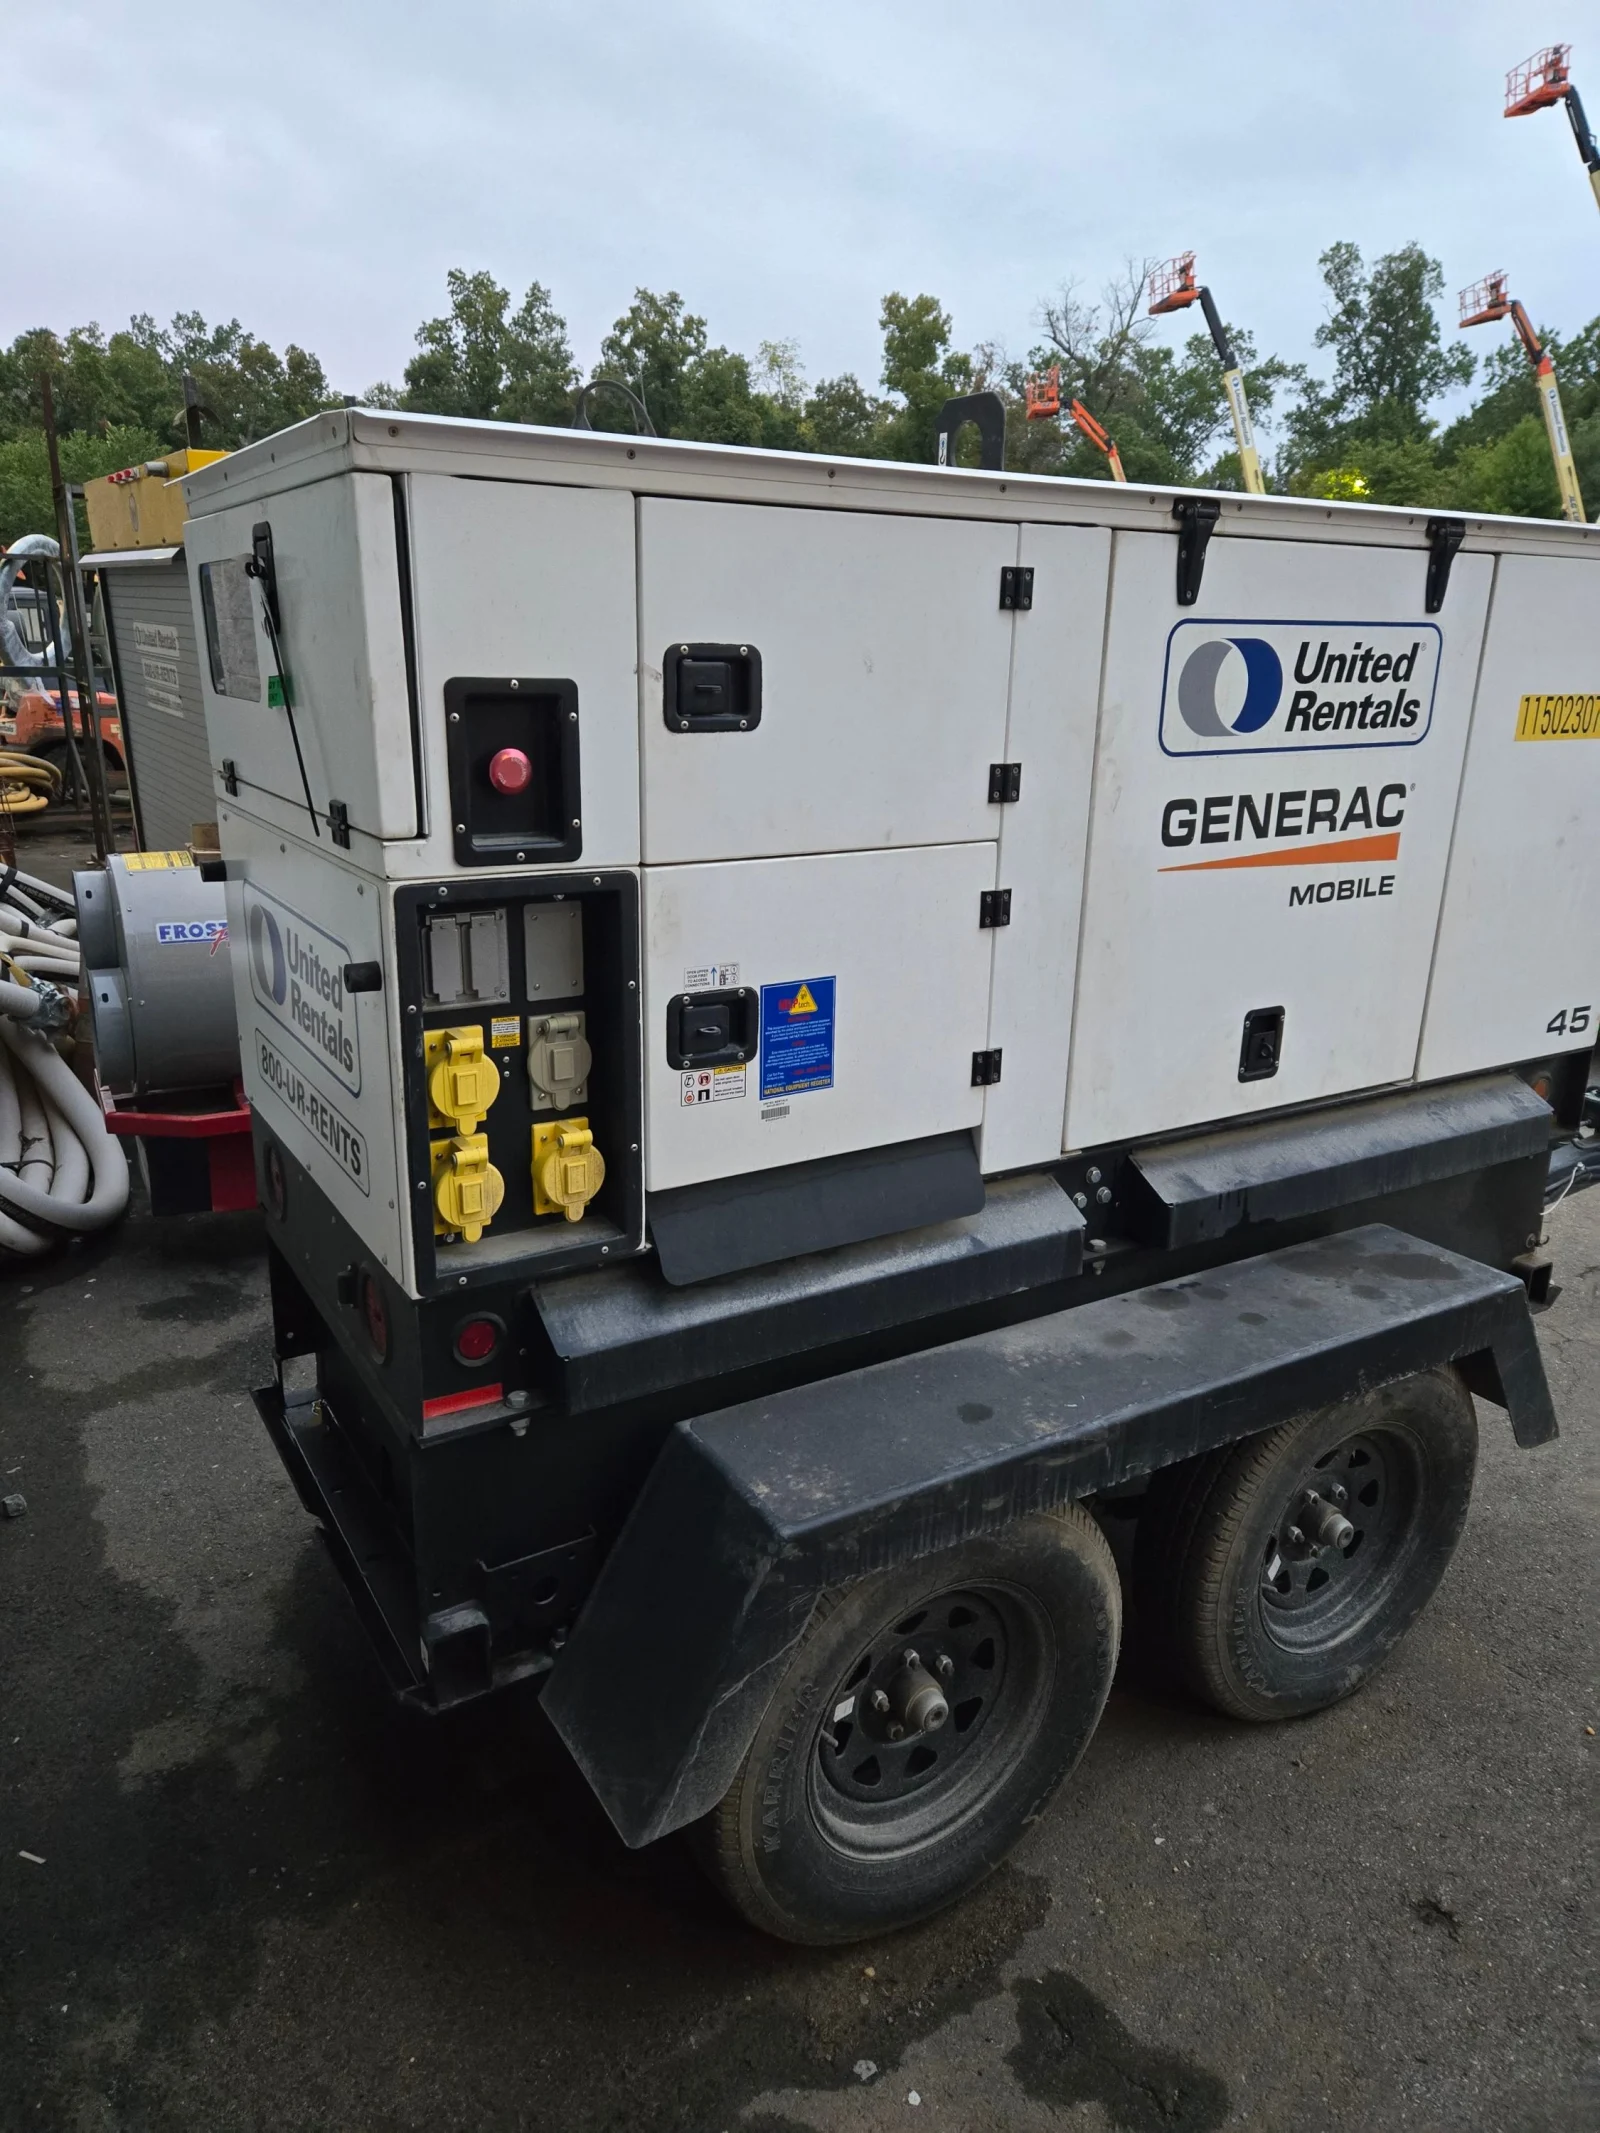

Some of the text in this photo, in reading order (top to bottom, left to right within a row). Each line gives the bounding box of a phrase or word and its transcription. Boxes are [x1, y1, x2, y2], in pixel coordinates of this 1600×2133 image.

[1294, 641, 1420, 685] United
[1284, 688, 1420, 732] Rentals
[1161, 783, 1407, 847] GENERAC
[1289, 875, 1396, 907] MOBILE
[286, 927, 343, 1013] United
[290, 978, 354, 1074] Rentals
[1546, 1005, 1591, 1036] 45
[261, 1044, 362, 1176] 800-UR-RENTS
